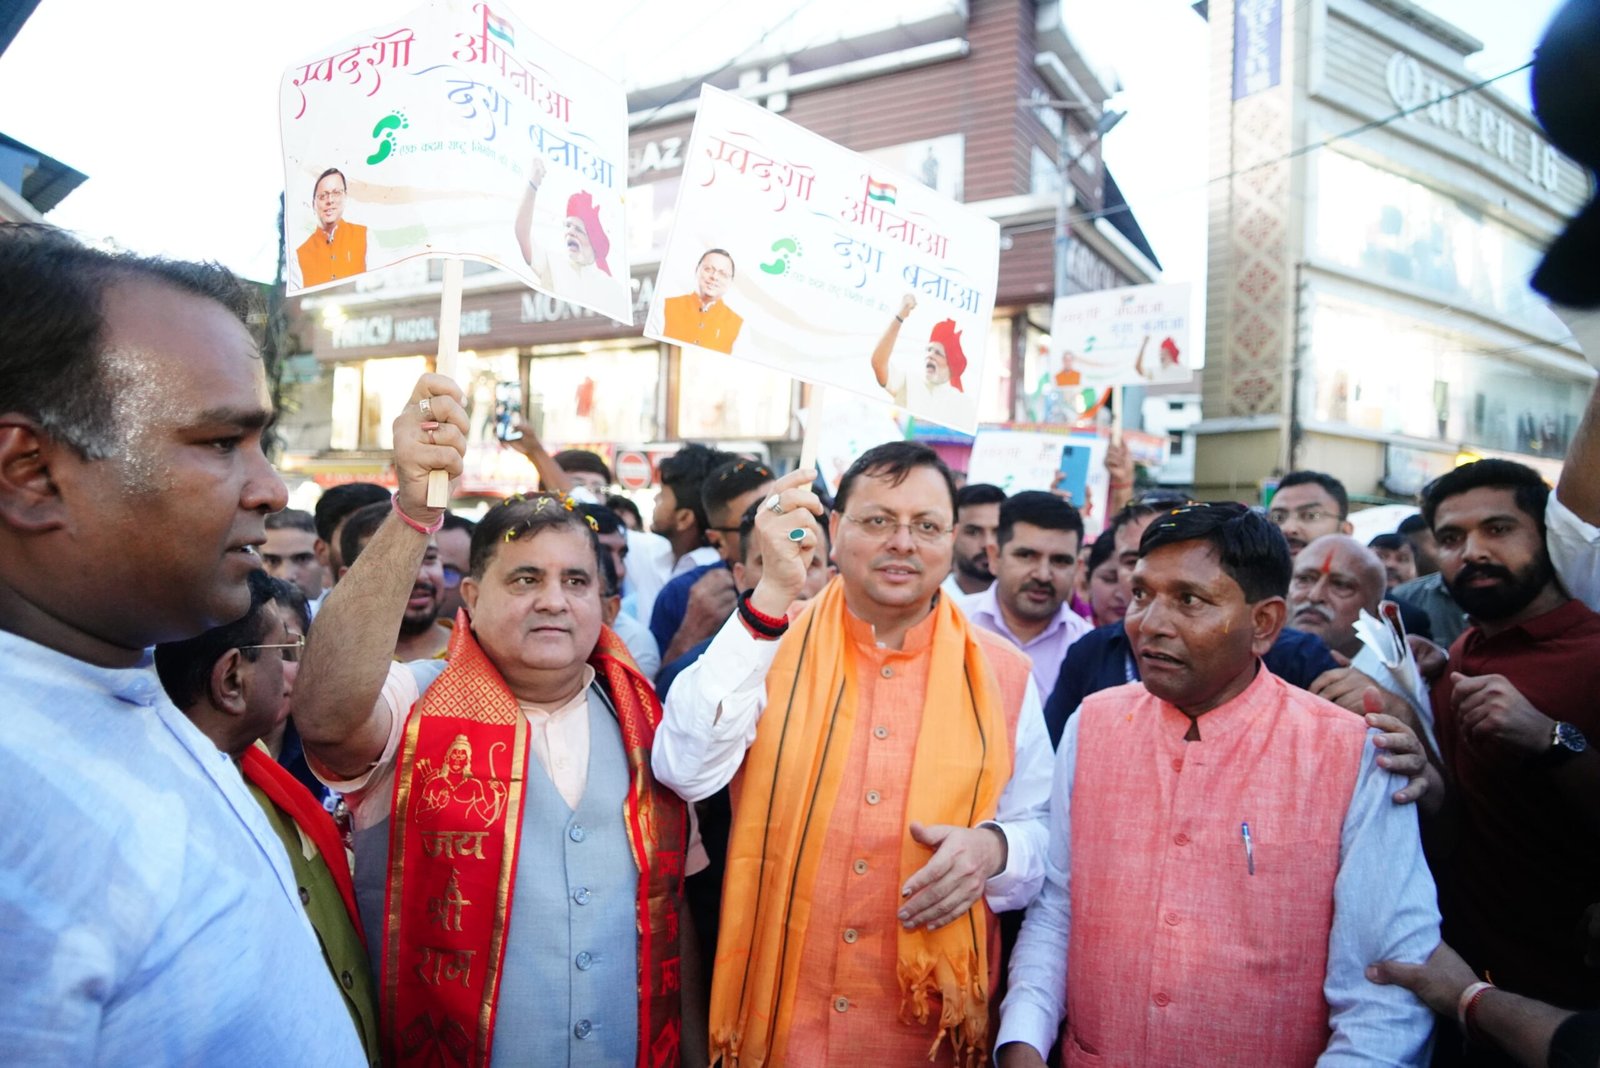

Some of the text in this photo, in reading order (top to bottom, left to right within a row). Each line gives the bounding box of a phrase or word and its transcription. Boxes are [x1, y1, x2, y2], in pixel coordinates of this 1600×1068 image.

[421, 831, 490, 860] जय
[428, 868, 472, 932] श्री
[415, 947, 477, 989] राम
